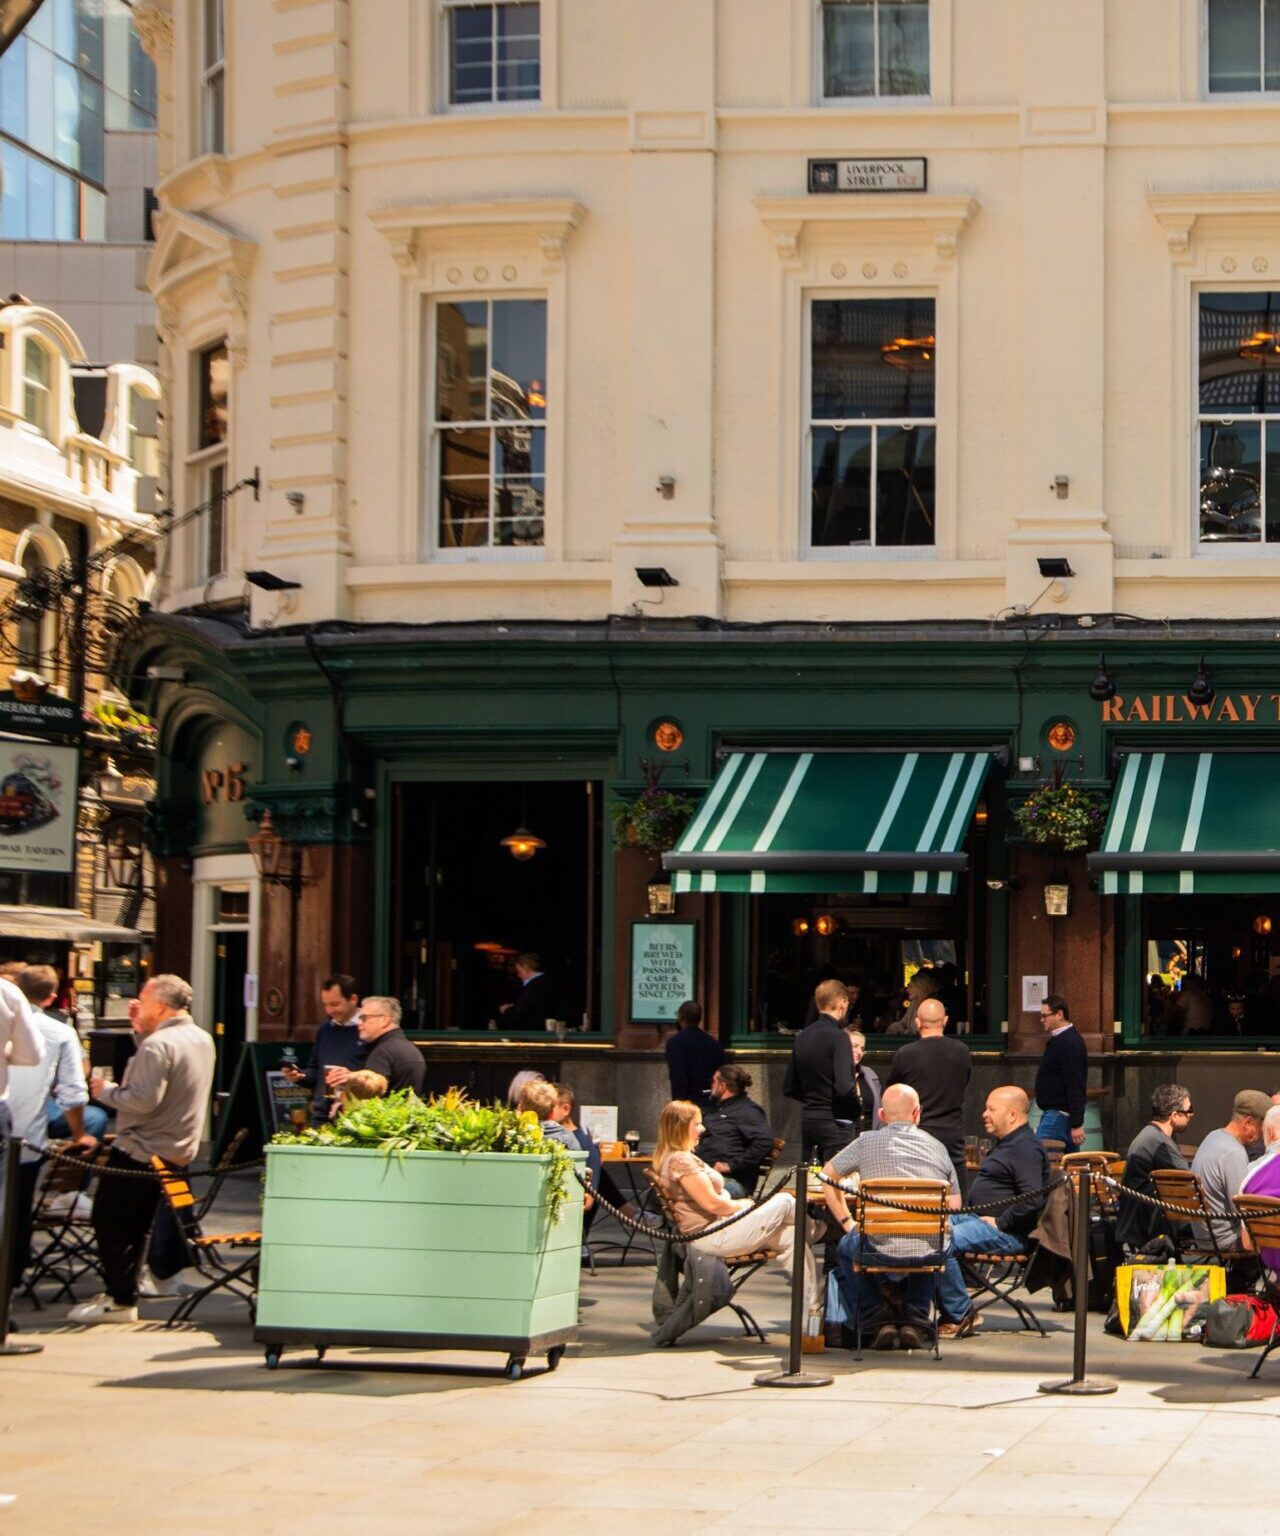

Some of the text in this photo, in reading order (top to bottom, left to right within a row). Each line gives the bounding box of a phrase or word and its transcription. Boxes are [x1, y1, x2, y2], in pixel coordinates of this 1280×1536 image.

[846, 164, 904, 174] LIVERPOOL
[846, 176, 917, 185] STREET EC2
[40, 705, 74, 719] KING
[1102, 695, 1261, 722] RAILWAY
[649, 943, 678, 951] BEERS
[643, 951, 683, 959] BREWED
[650, 959, 676, 967] WITH
[639, 990, 687, 999] SINCE 1799
